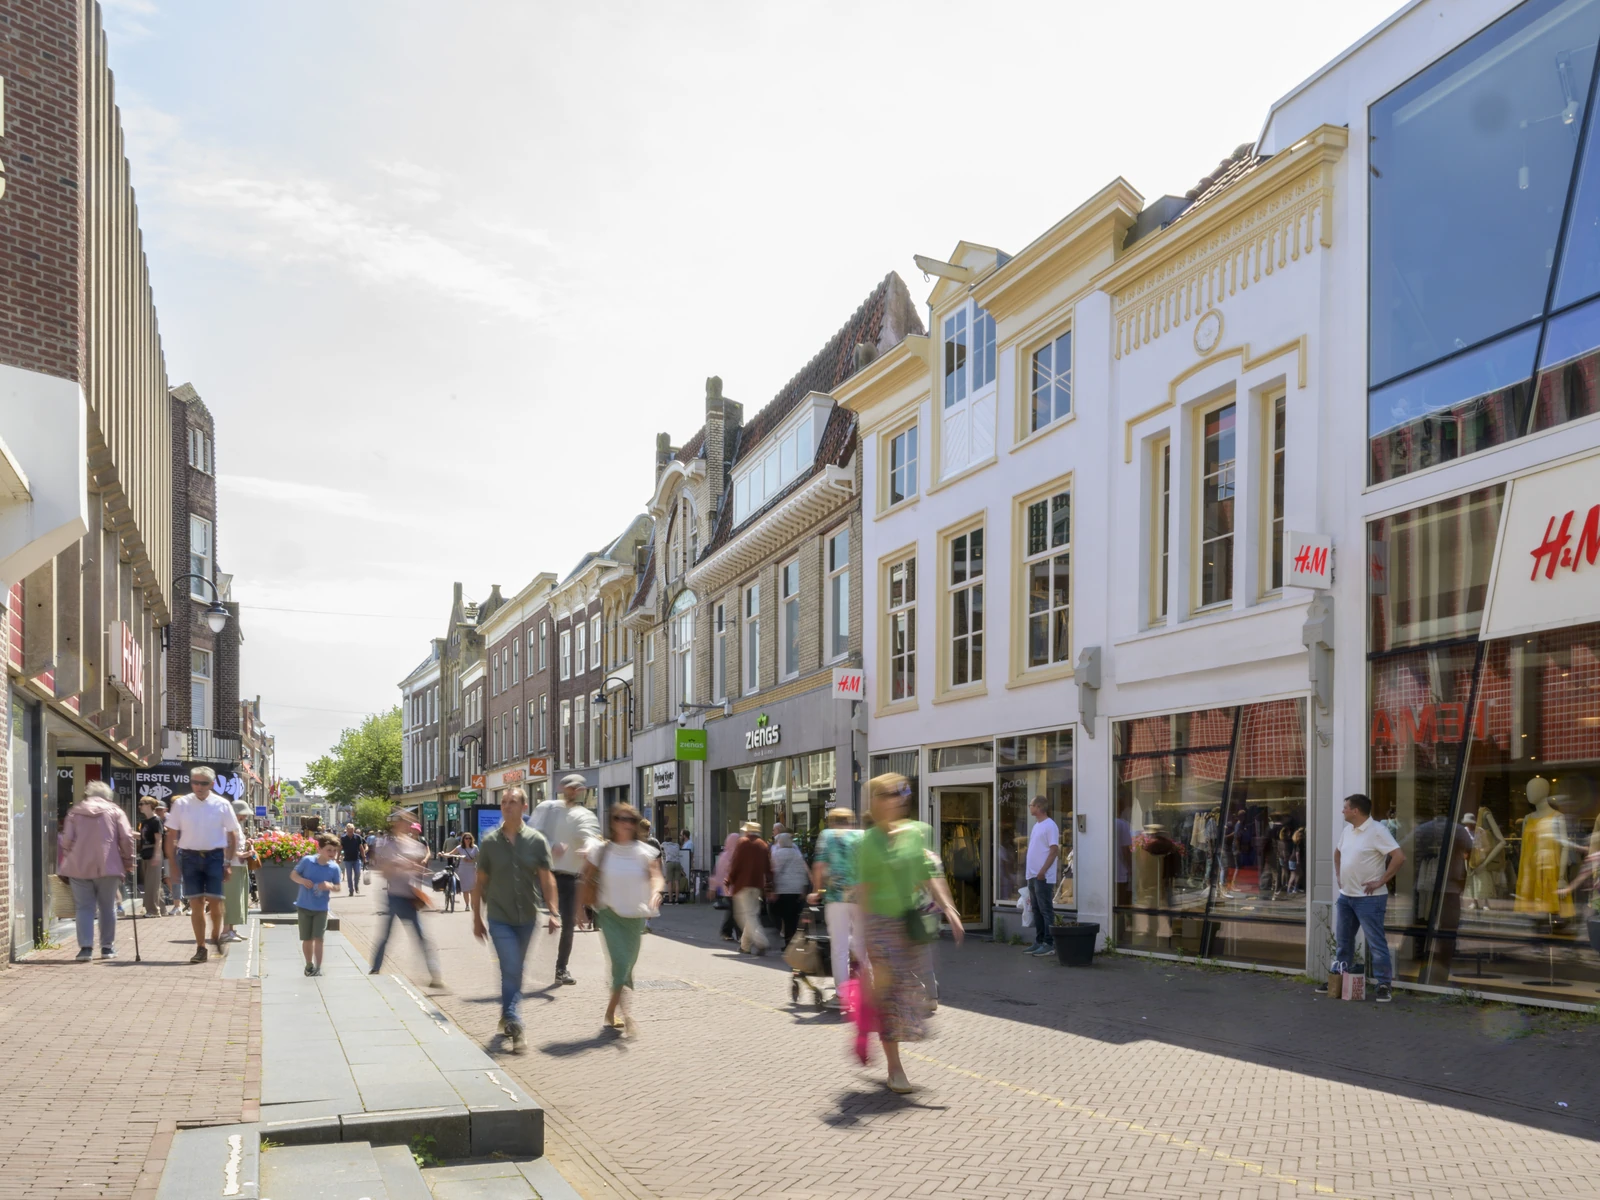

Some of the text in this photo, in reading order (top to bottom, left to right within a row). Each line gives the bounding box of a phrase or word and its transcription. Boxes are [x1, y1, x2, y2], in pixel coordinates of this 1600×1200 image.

[1294, 544, 1328, 576] H&M
[837, 675, 861, 693] H&M
[745, 724, 780, 750] ZIENGS
[173, 774, 190, 783] VIS
